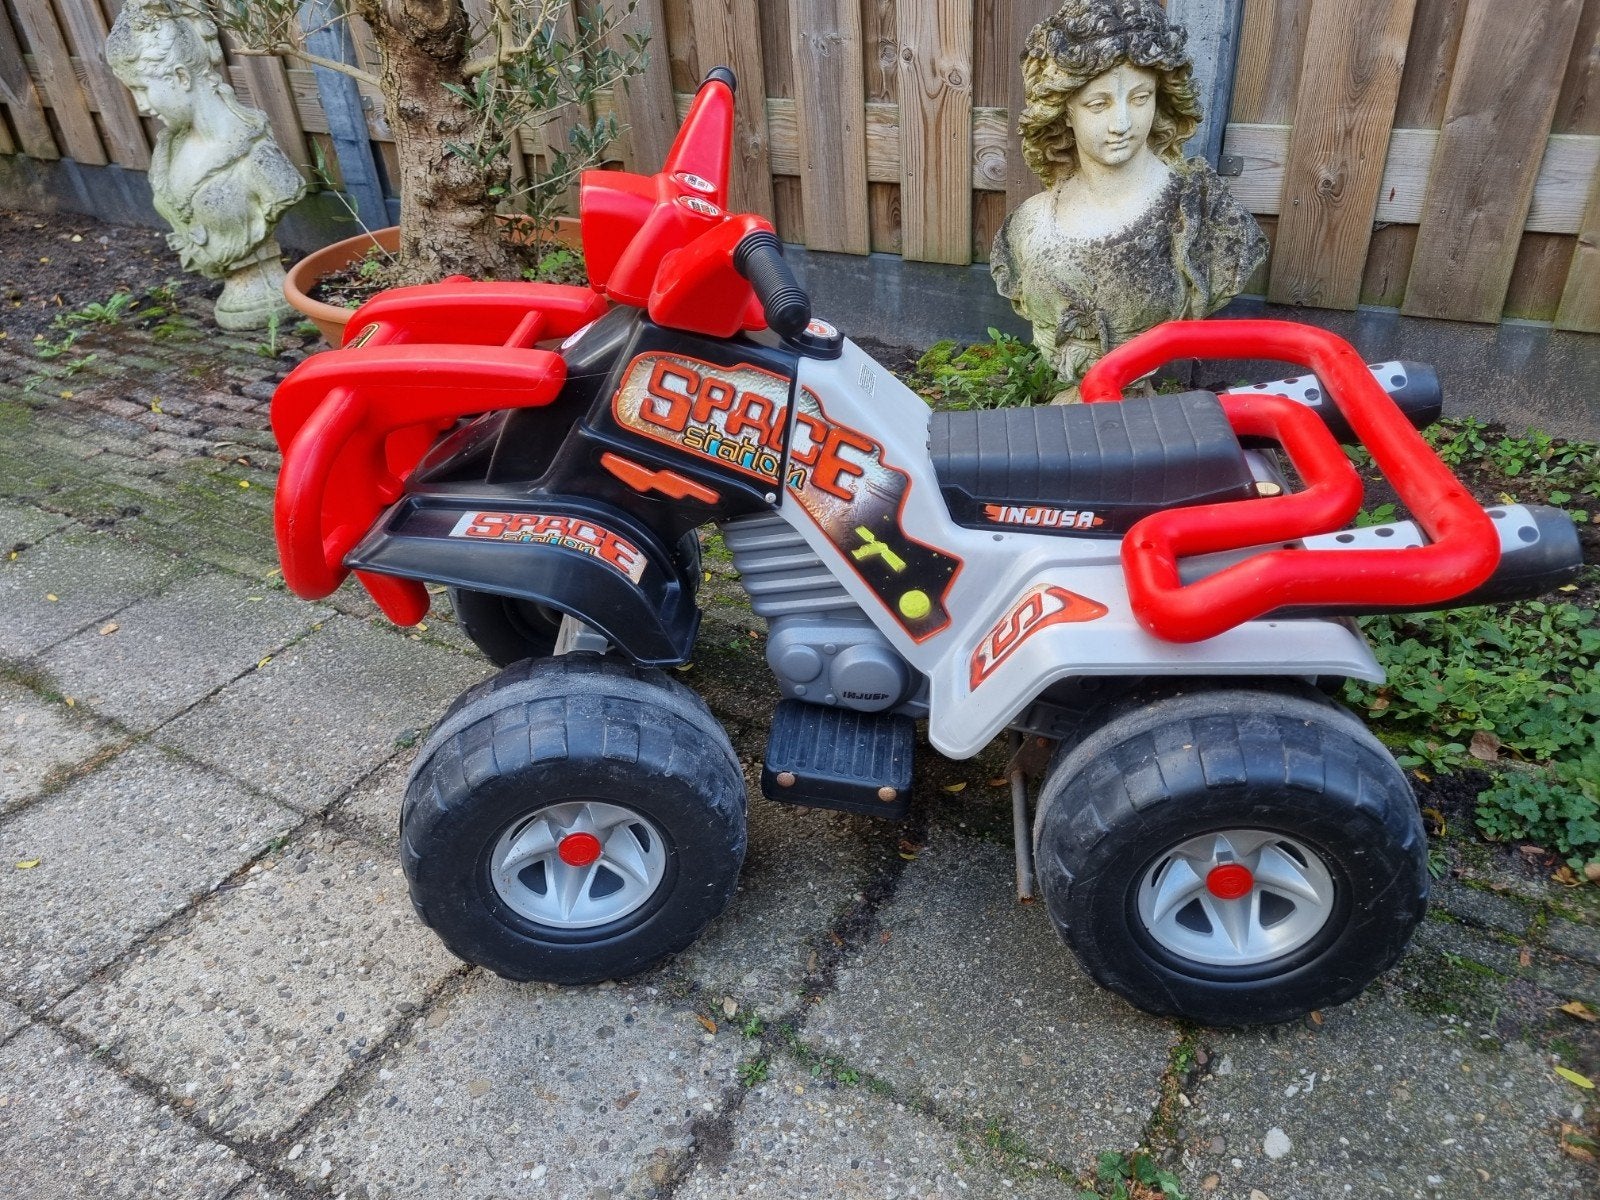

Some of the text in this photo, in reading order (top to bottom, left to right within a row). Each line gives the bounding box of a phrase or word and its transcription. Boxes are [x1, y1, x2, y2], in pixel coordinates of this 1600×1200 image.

[639, 359, 873, 500] SPACE
[683, 422, 806, 490] station
[465, 511, 639, 574] SPACE
[501, 530, 596, 556] station
[998, 506, 1095, 528] INJUSA
